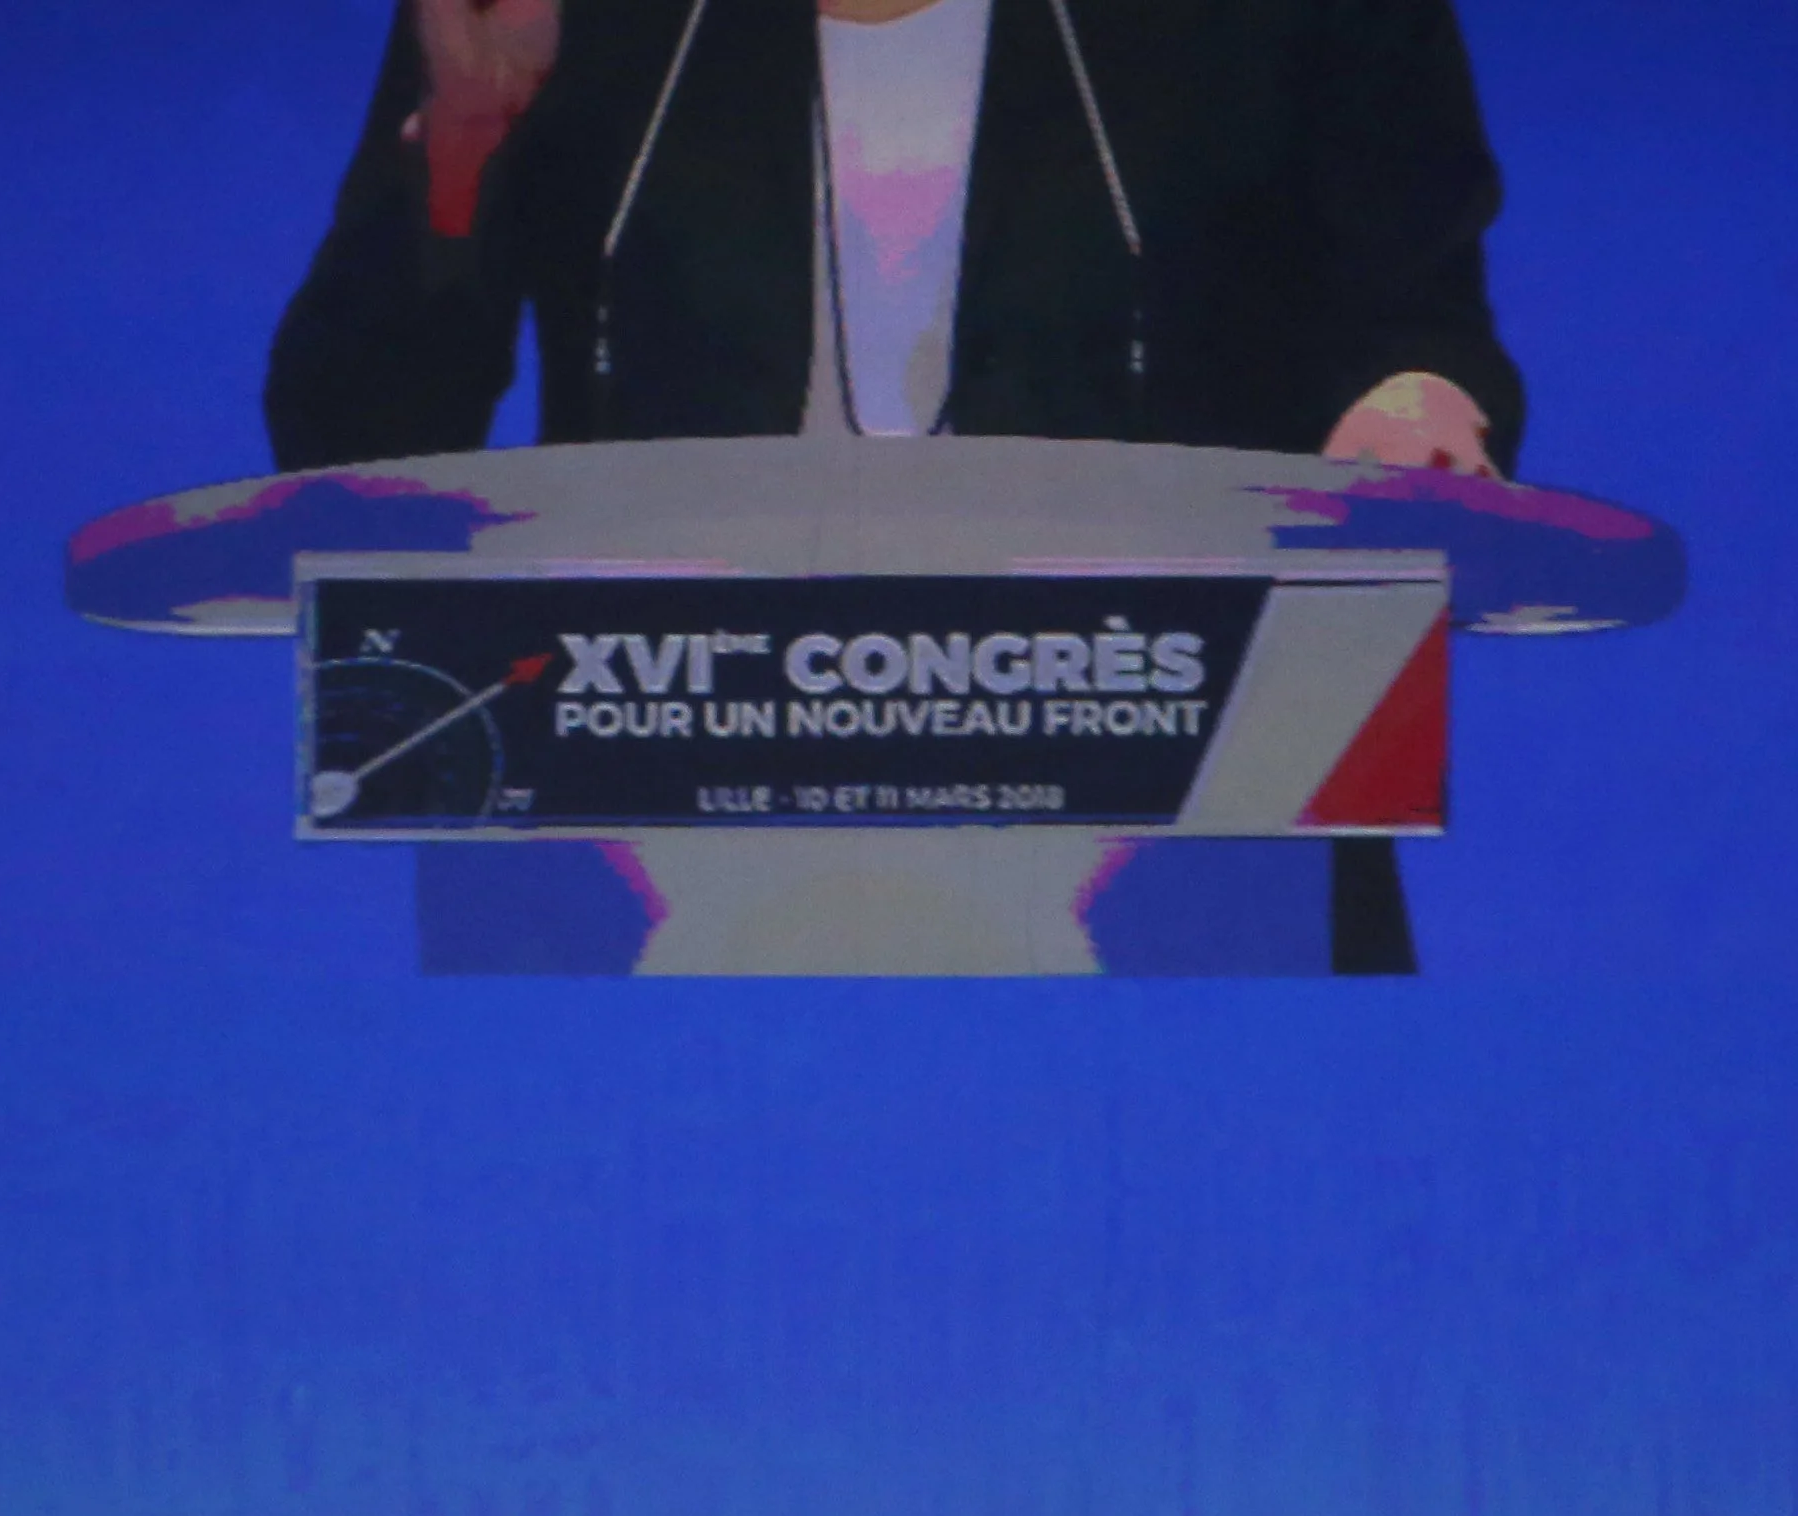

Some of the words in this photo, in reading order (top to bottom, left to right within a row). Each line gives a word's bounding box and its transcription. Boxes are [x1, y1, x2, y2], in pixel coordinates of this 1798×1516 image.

[784, 614, 1206, 693] CONGRÈS
[555, 700, 693, 738] POUR
[704, 700, 776, 738] UN
[786, 700, 1032, 738] NOUVEAU
[1042, 700, 1208, 736] FRONT
[697, 785, 771, 812] LILLE
[792, 785, 829, 812] 10
[833, 785, 872, 812] ET
[874, 785, 900, 811] 11
[905, 784, 992, 810] MARS
[996, 784, 1065, 810] 2018
